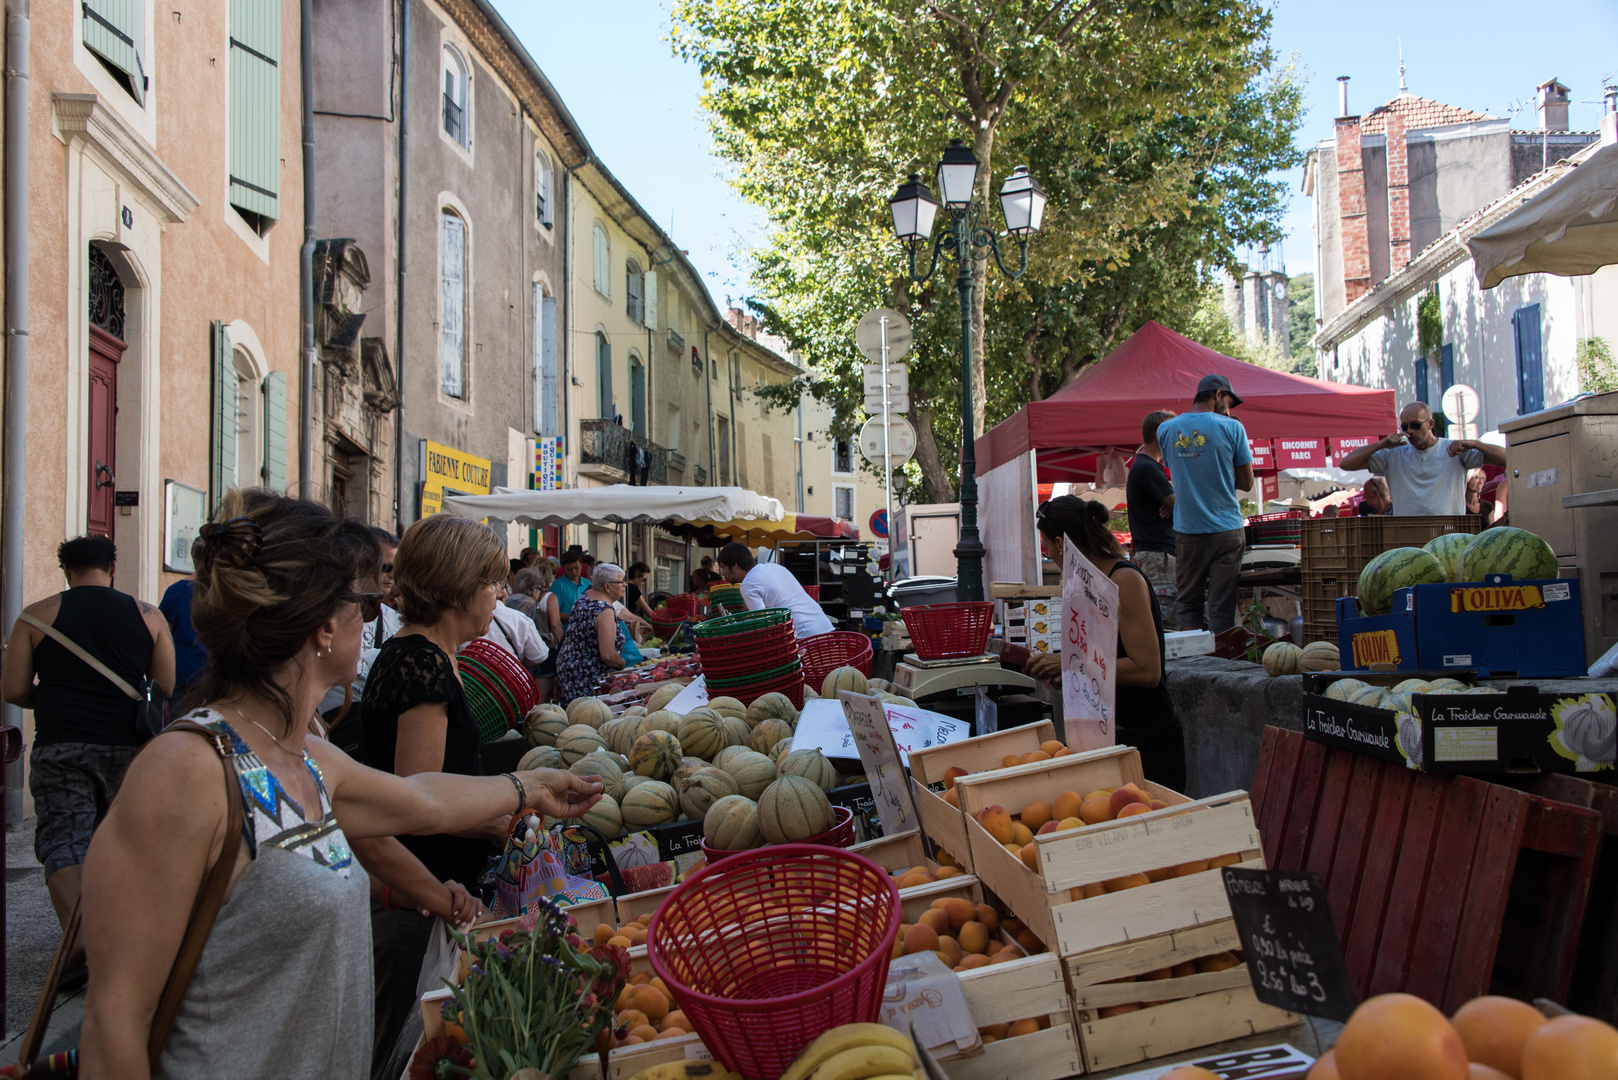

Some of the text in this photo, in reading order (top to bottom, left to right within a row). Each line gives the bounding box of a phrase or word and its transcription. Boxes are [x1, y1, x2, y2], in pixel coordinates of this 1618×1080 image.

[1254, 446, 1270, 455] TERRE
[1282, 441, 1317, 450] ENCORNET
[1340, 438, 1368, 448] ROUILLE
[1291, 451, 1311, 461] FARCI
[429, 450, 489, 488] FABIENNE COUTURE
[1470, 588, 1526, 609] OLIVA
[1361, 634, 1391, 663] OLIVA
[1306, 707, 1317, 731] La
[1431, 707, 1445, 721] La
[1492, 706, 1547, 721] Gourmande
[669, 839, 683, 851] La
[1225, 870, 1311, 896] POMELOS AFRIQUE
[1306, 971, 1327, 1003] 3
